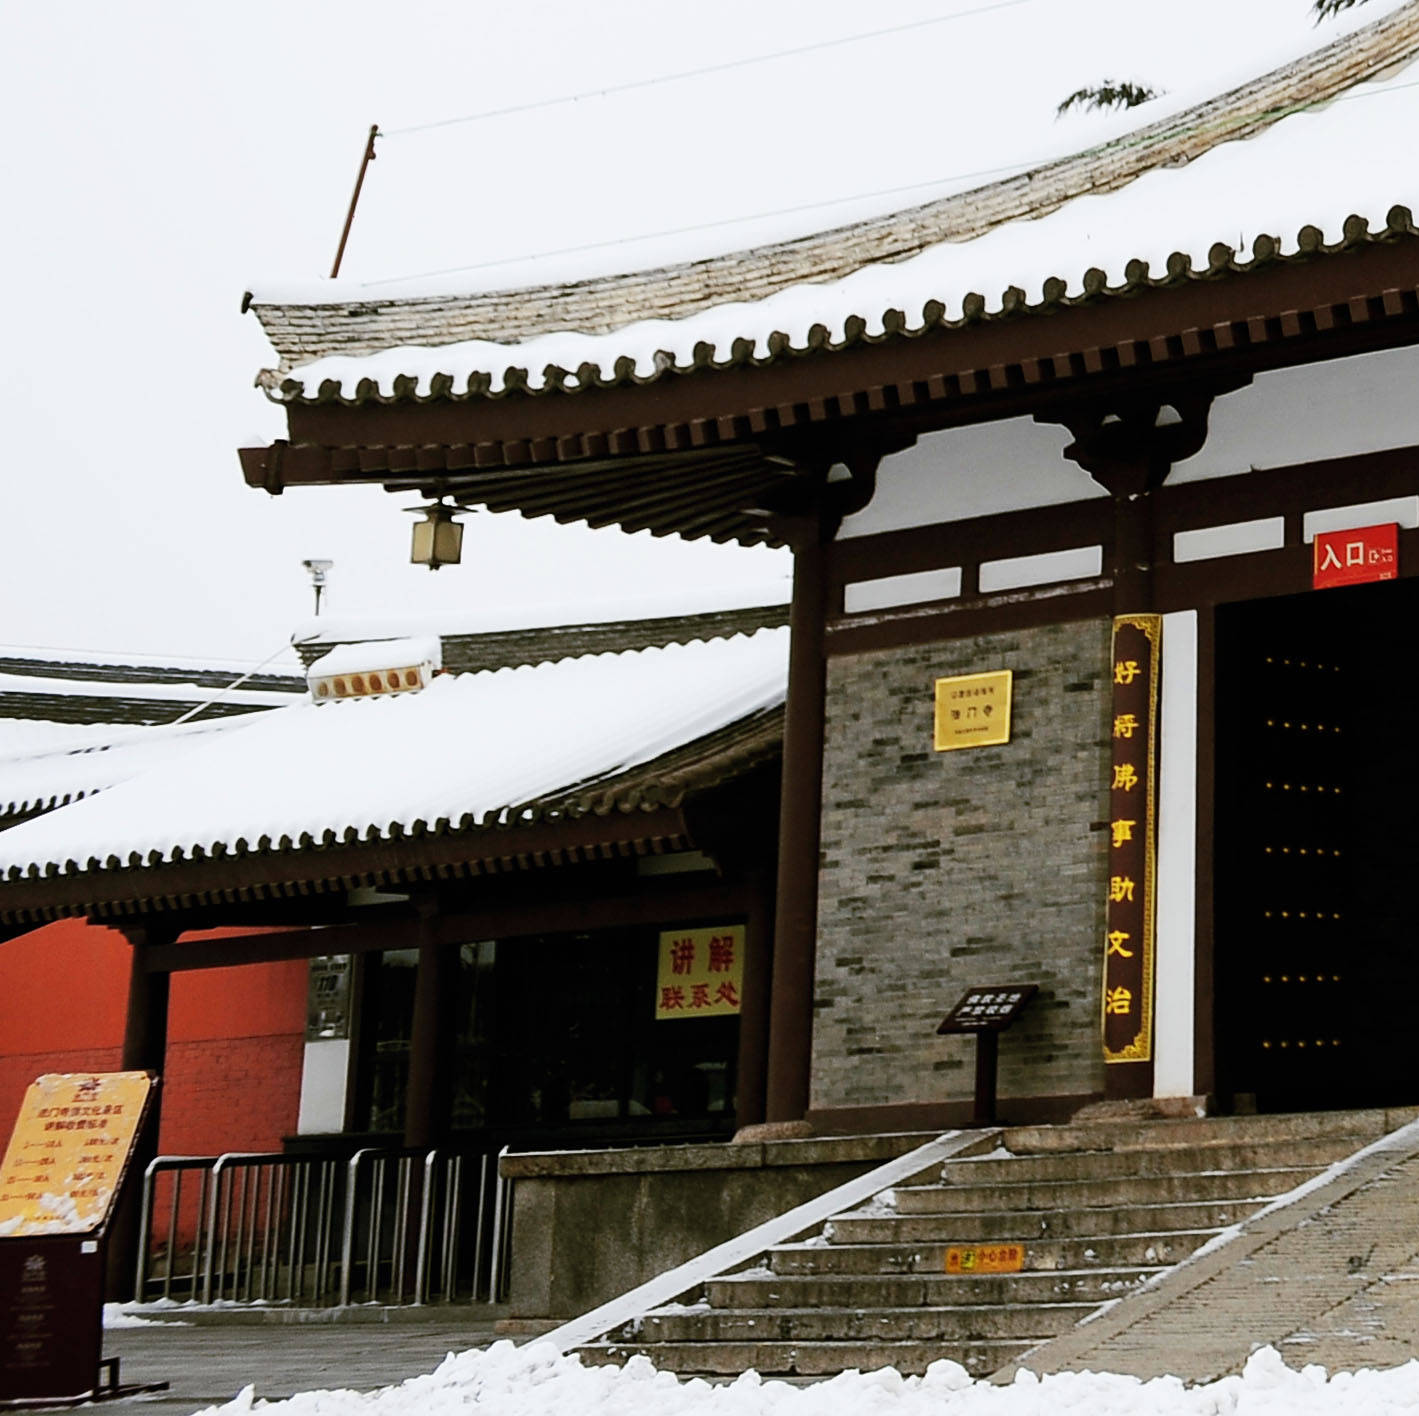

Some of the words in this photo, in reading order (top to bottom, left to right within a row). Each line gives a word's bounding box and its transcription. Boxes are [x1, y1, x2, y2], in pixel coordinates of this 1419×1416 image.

[1320, 541, 1364, 571] 入口
[670, 935, 735, 975] 讲解
[659, 980, 741, 1010] 联系处
